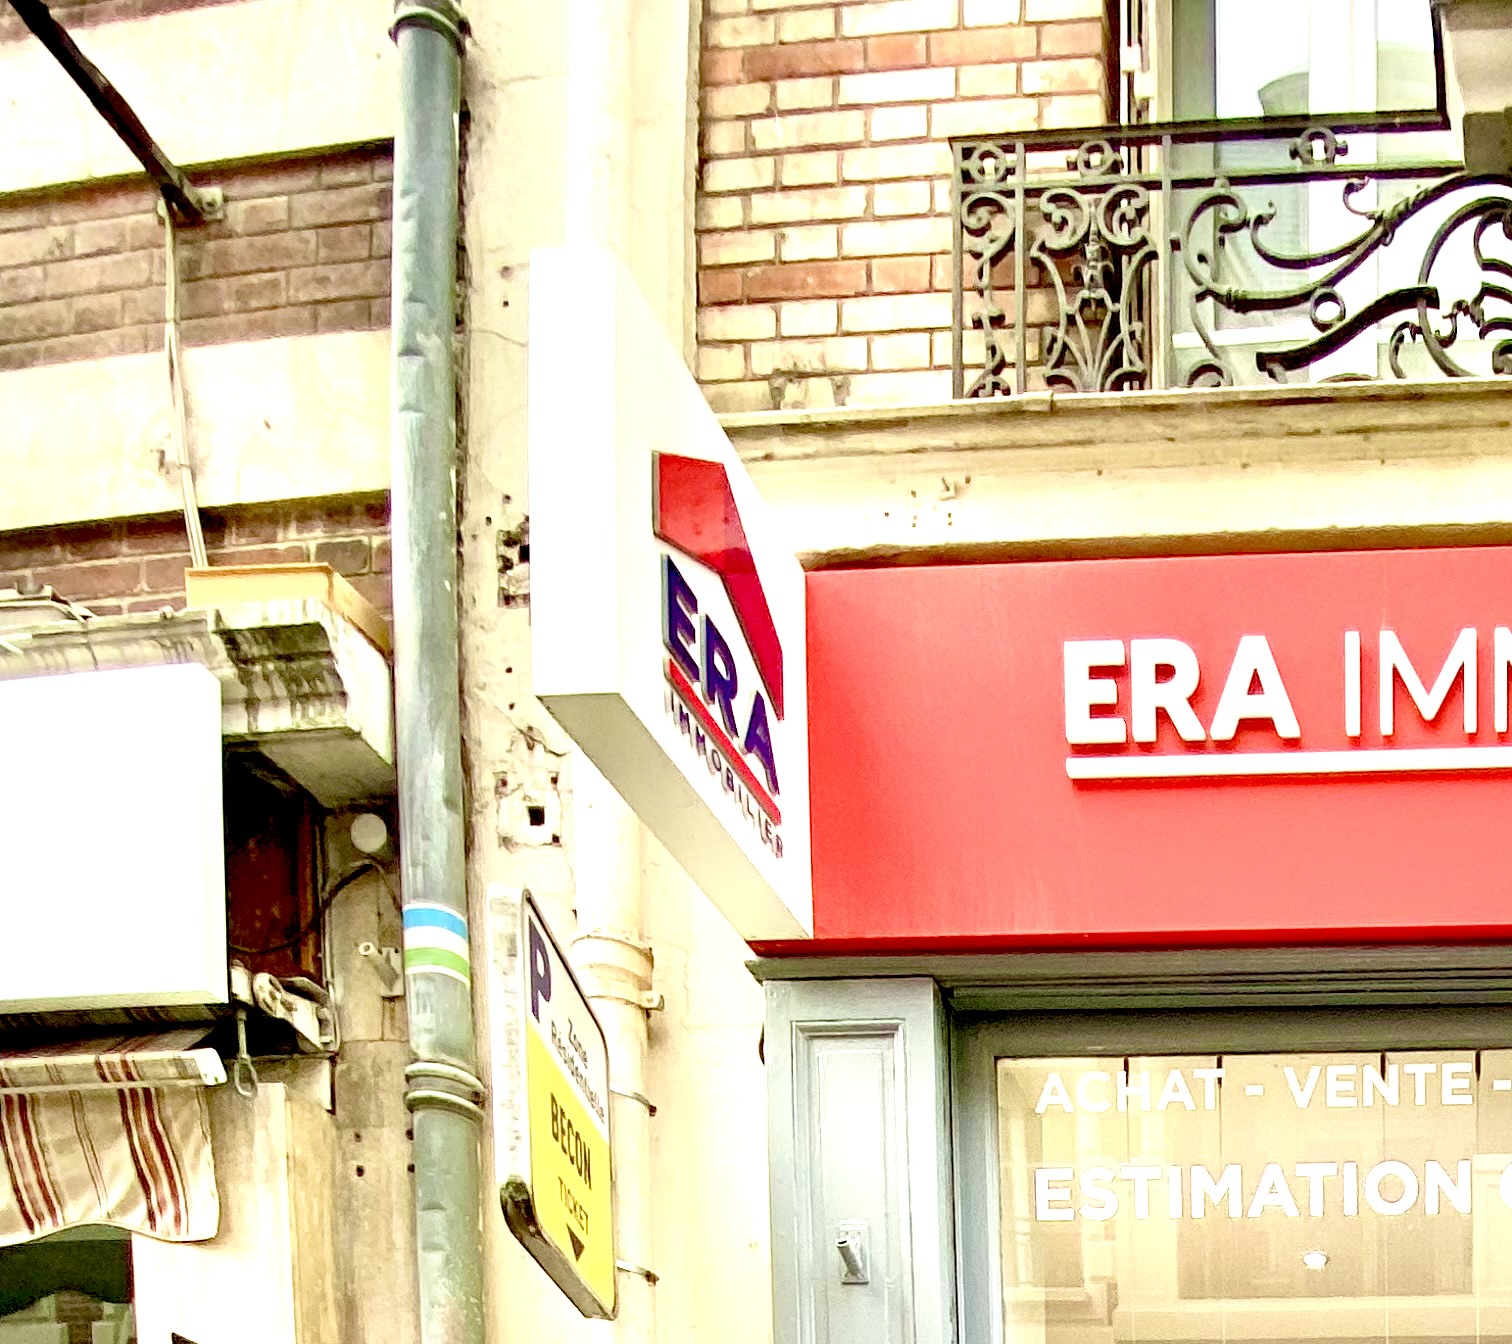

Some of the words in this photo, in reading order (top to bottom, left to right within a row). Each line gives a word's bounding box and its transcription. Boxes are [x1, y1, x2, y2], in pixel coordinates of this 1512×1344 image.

[661, 553, 780, 796] ERA
[1064, 634, 1300, 744] ERA
[664, 689, 784, 859] IMMOBILIER
[529, 915, 551, 1024] P
[1034, 1066, 1225, 1114] ACHAT
[1282, 1061, 1473, 1109] VENTE
[551, 1091, 592, 1191] BECON
[1034, 1159, 1473, 1222] ESTIMATION
[558, 1175, 589, 1236] TICKET
